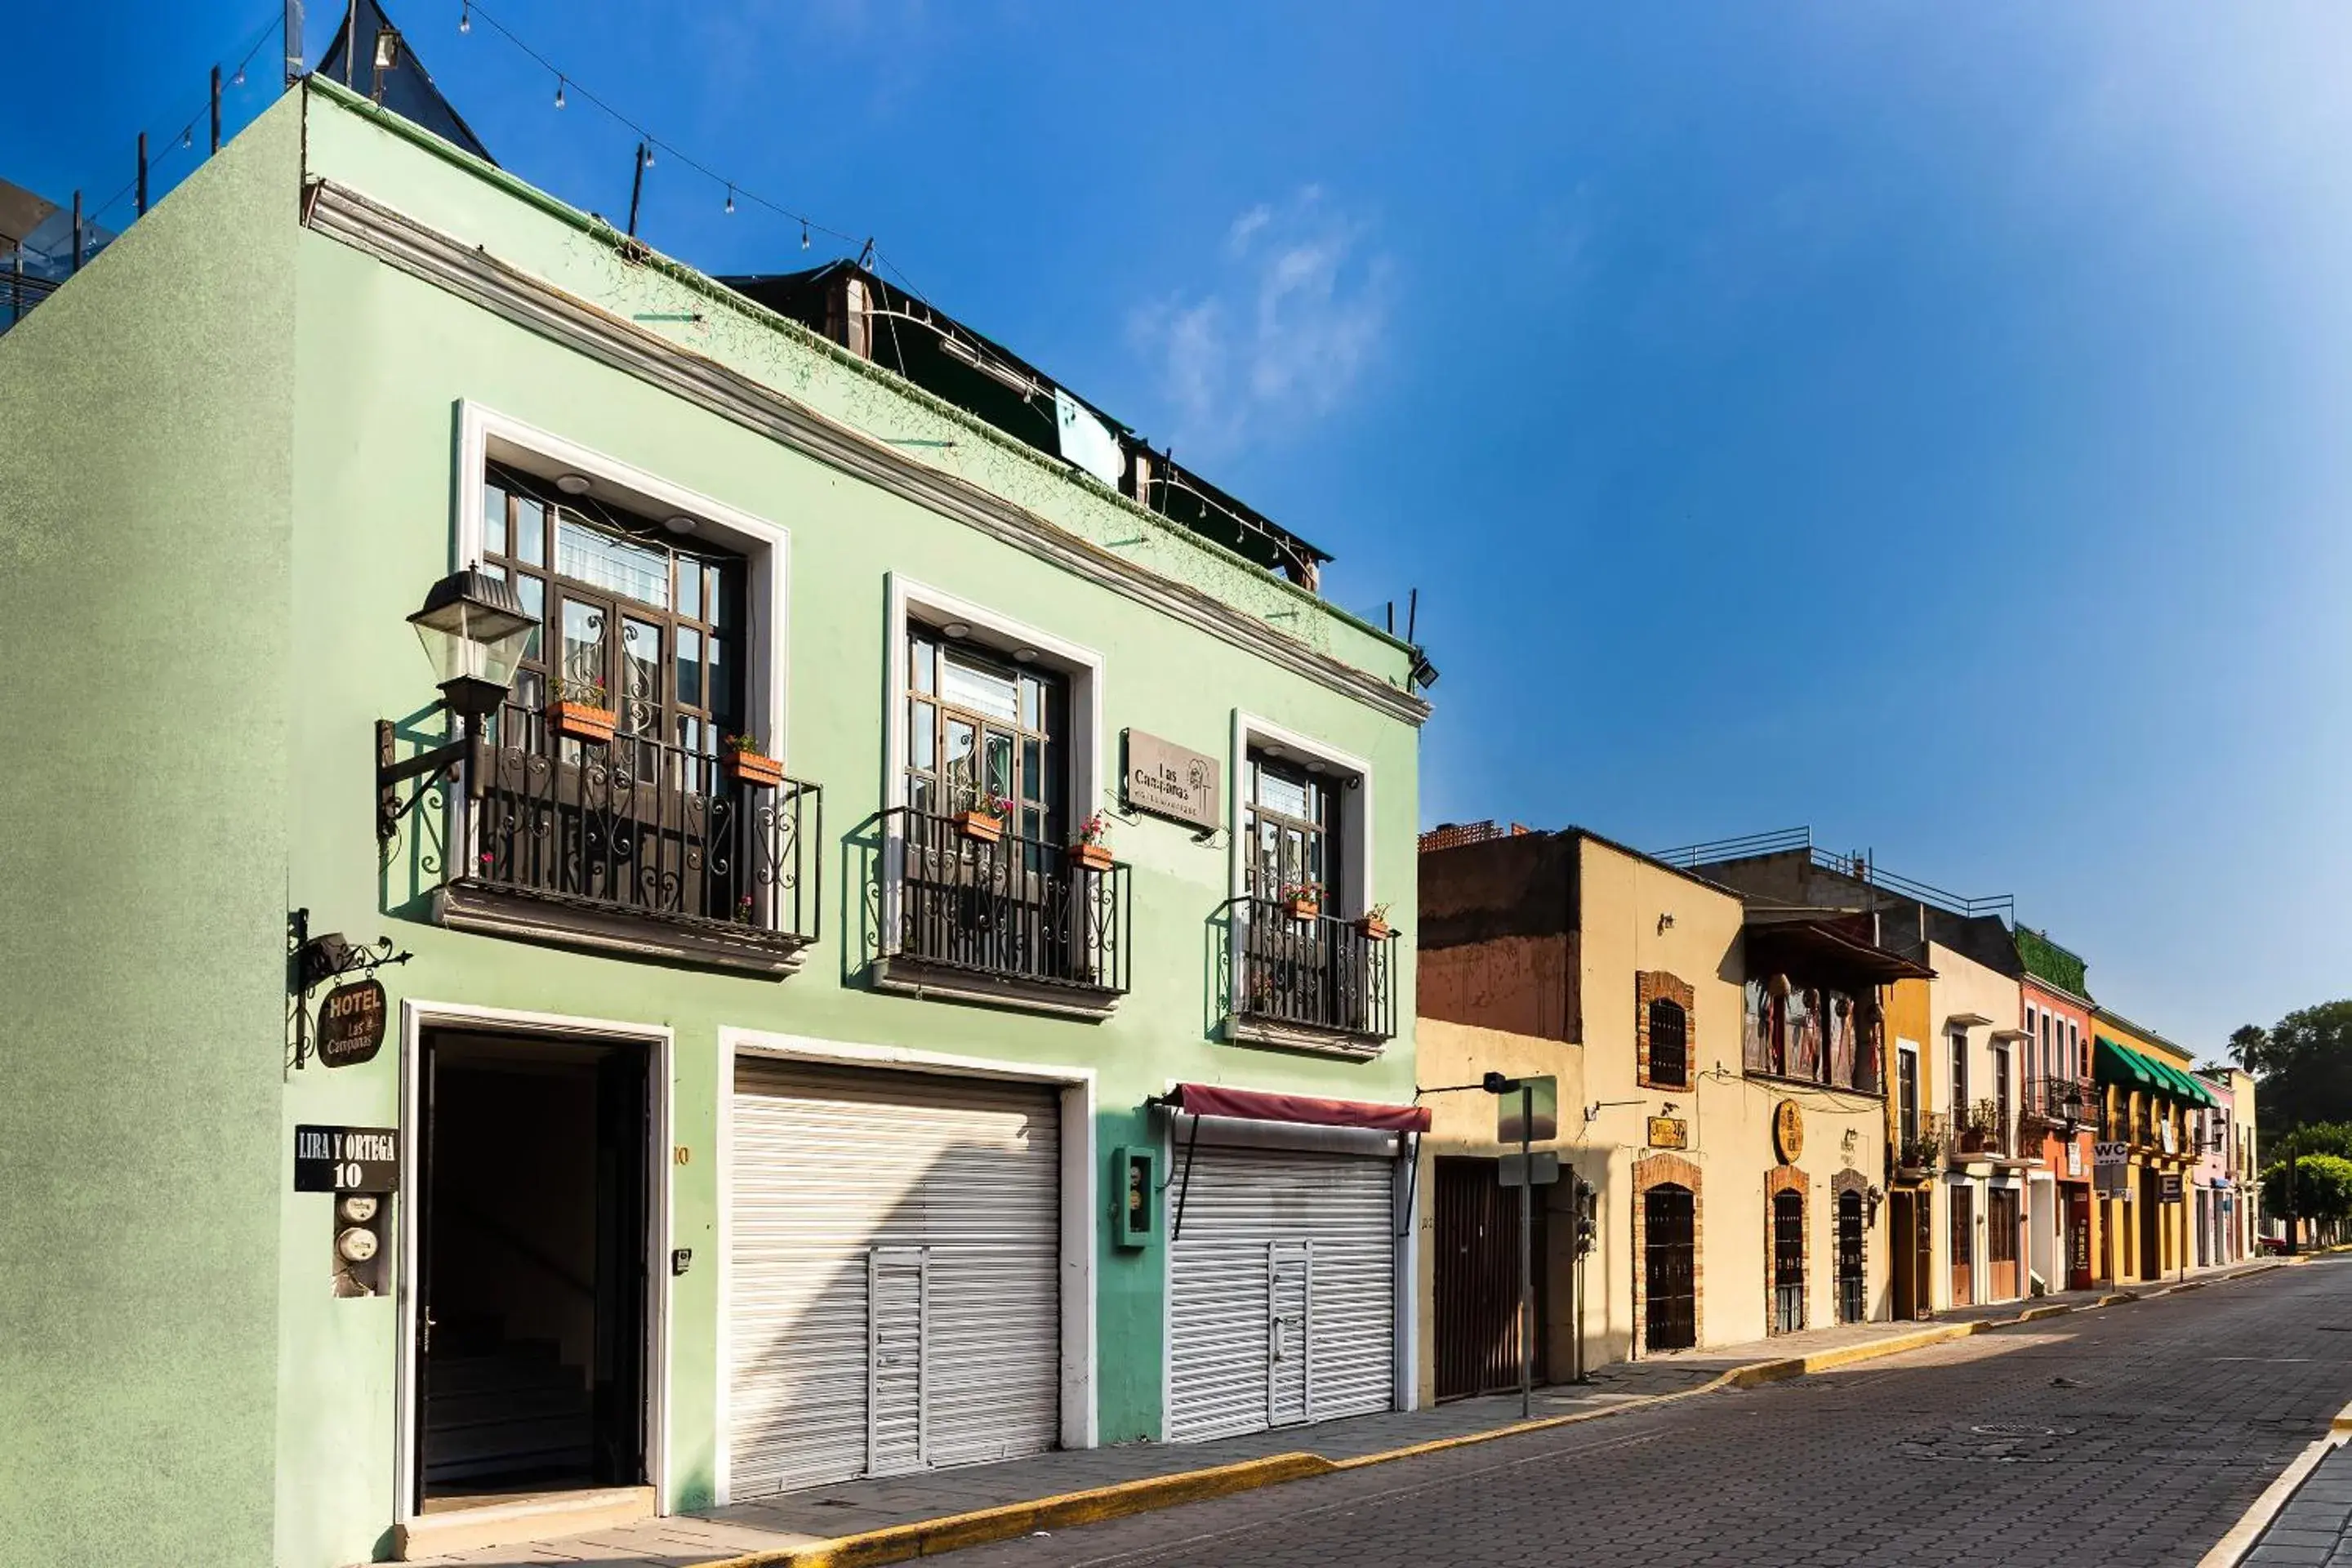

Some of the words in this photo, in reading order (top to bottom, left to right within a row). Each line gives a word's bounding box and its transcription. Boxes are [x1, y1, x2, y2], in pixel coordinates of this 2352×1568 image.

[330, 989, 381, 1018] HOTEL
[348, 1022, 364, 1036] Las
[327, 1035, 372, 1054] Campanas
[299, 1132, 330, 1160] LIRA
[334, 1134, 342, 1160] Y
[346, 1134, 394, 1161] ORTEGA
[2095, 1143, 2126, 1156] WC
[334, 1163, 362, 1187] 10
[2163, 1177, 2180, 1194] E
